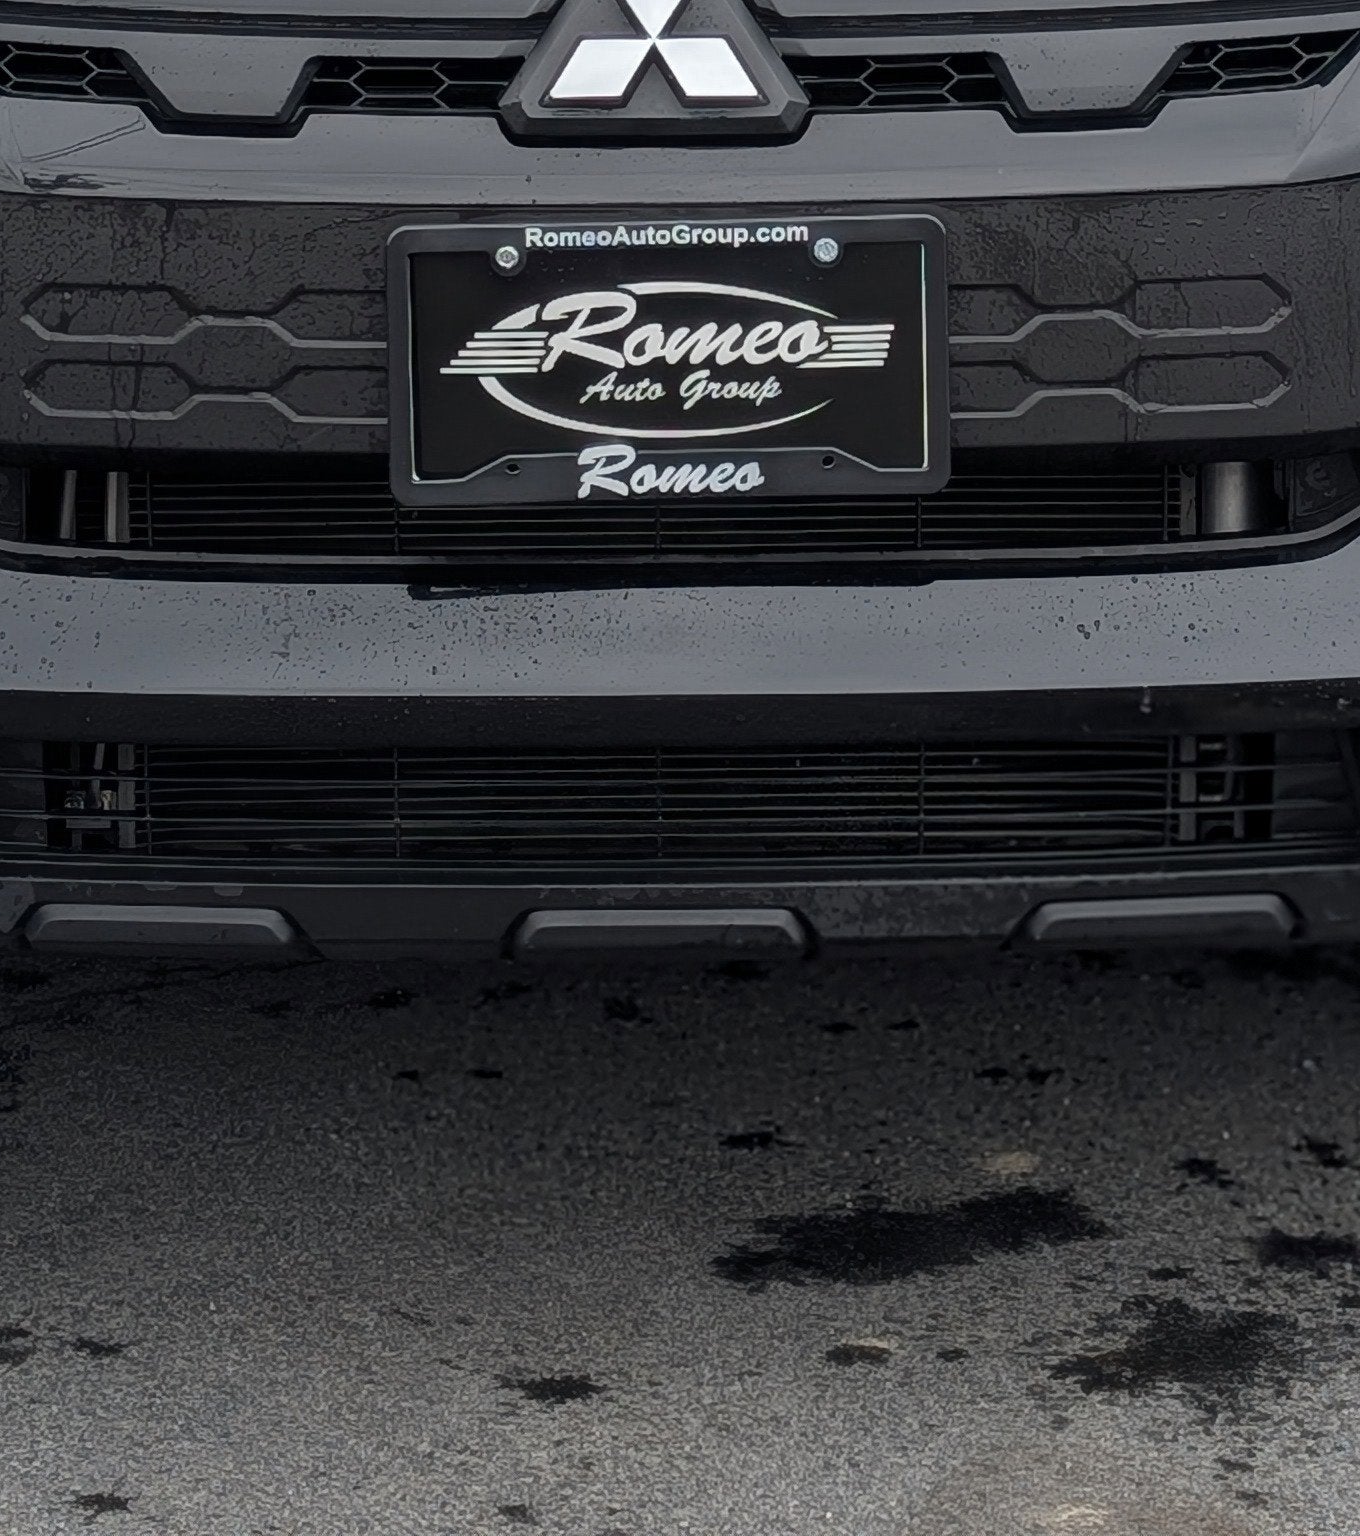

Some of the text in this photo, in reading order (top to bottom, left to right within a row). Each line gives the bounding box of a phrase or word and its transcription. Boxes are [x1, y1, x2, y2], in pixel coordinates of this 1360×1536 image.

[525, 224, 809, 247] RomeoAutoGroup.com
[541, 291, 829, 372] Romeo
[579, 369, 783, 410] Auto Group
[577, 444, 766, 499] Romeo
